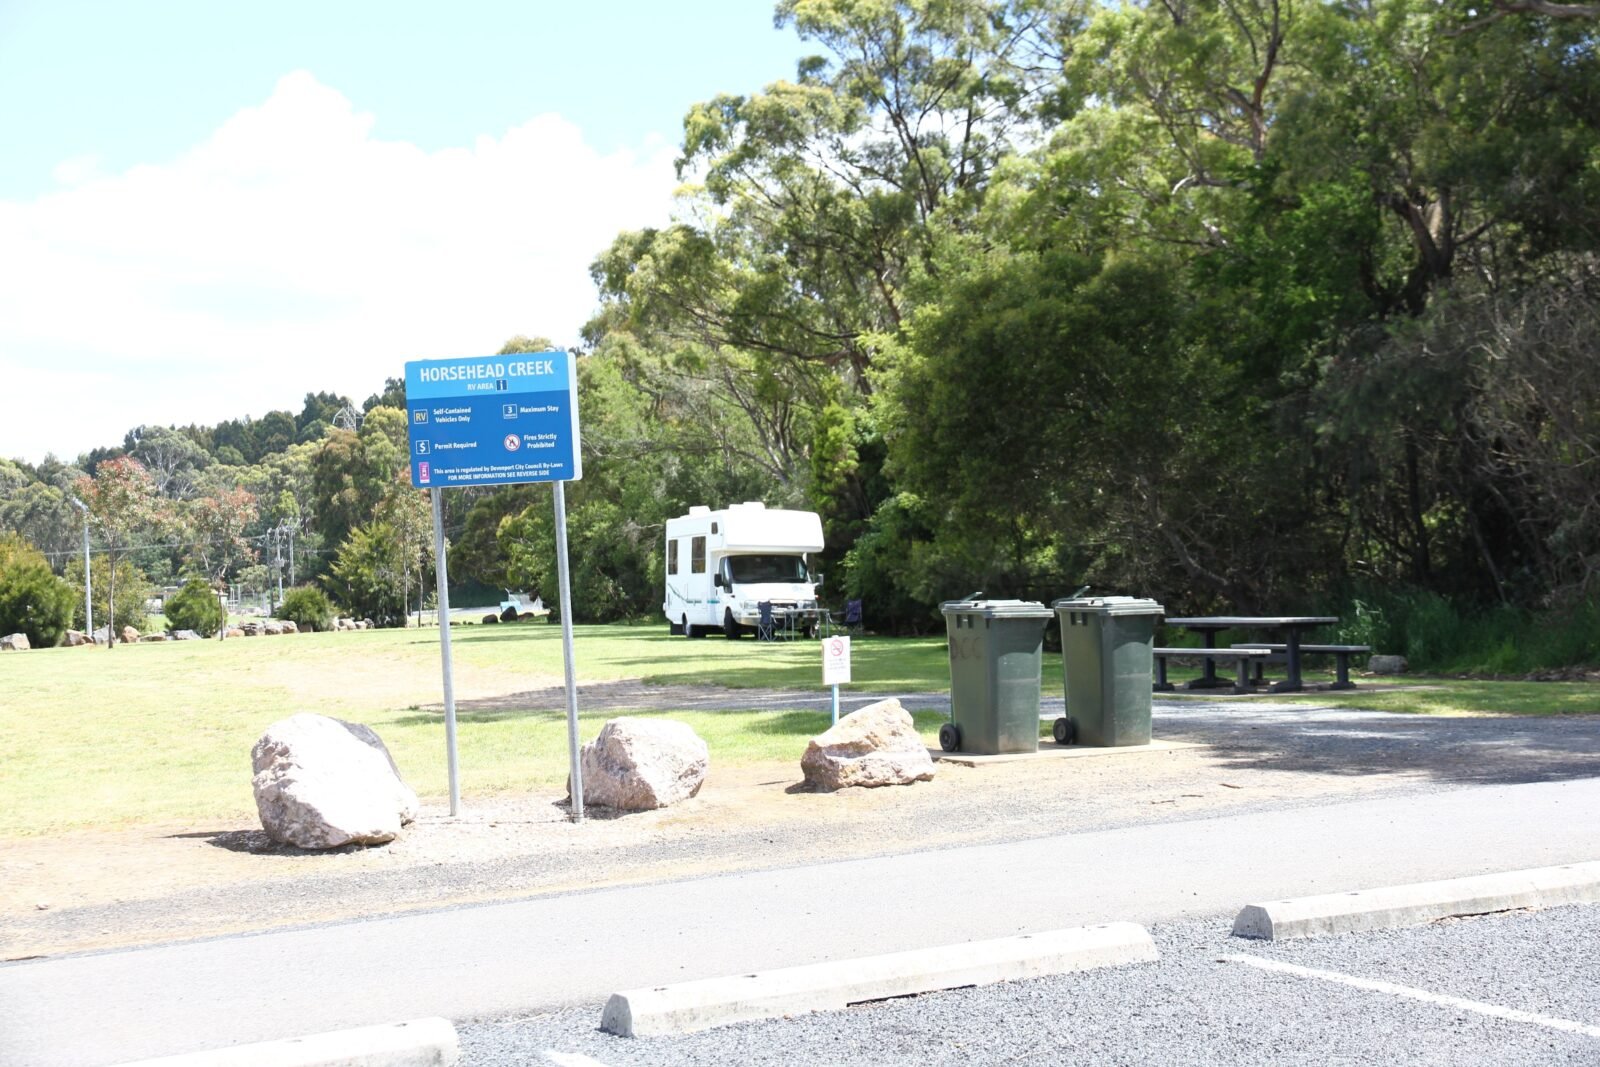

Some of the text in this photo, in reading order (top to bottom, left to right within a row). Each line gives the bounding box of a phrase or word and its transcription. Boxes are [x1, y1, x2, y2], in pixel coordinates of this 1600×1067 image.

[420, 360, 554, 382] HORSEHEAD CREEK
[416, 413, 426, 421] RV
[420, 442, 426, 453] $
[453, 441, 477, 450] Required
